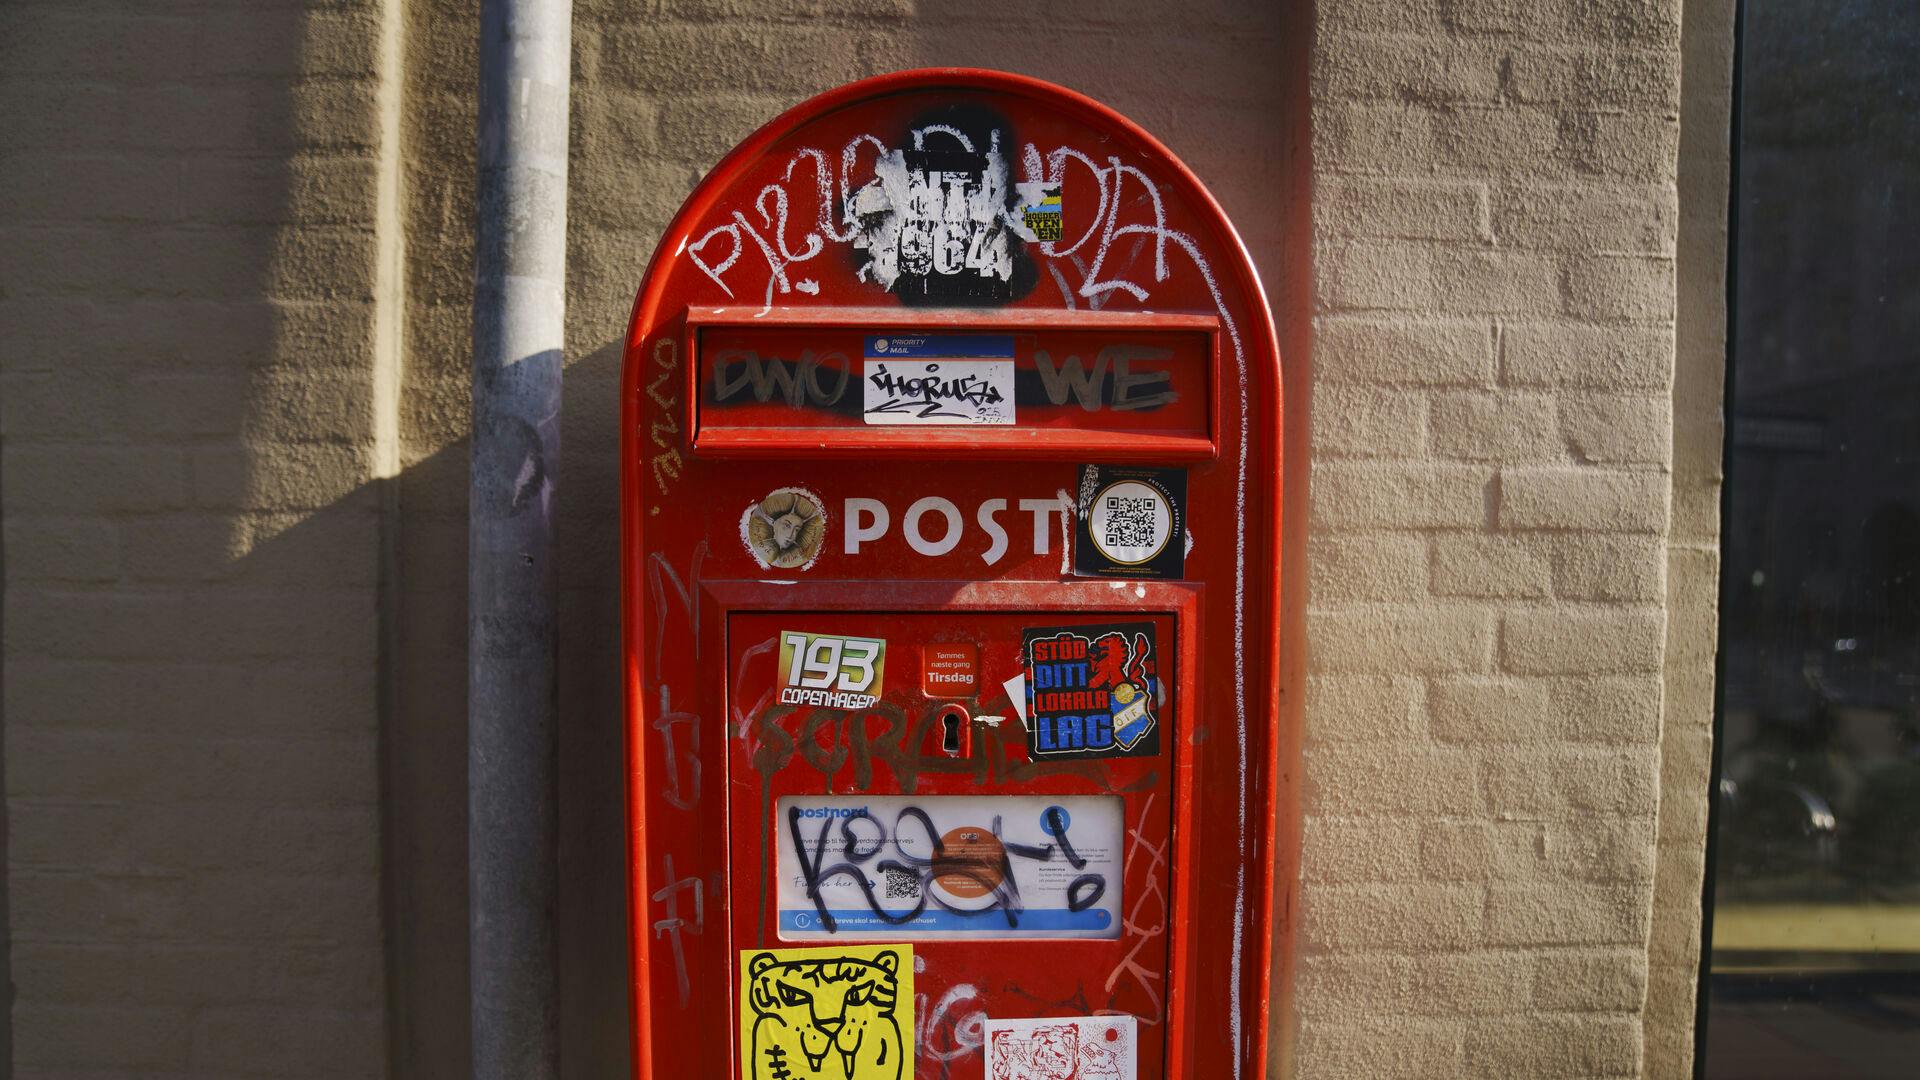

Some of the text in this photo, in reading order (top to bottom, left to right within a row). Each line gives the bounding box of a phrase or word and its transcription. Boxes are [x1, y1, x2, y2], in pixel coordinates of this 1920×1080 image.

[1033, 228, 1061, 240] EN
[1034, 344, 1181, 412] WE
[844, 496, 1064, 566] POST
[1035, 637, 1086, 661] STÖD
[786, 635, 880, 691] 193
[928, 672, 974, 685] Tirsdag
[1035, 663, 1088, 689] DITT
[781, 688, 876, 709] COPENHAGEN
[1036, 690, 1108, 712] LOKALA
[1039, 714, 1112, 750] LAG
